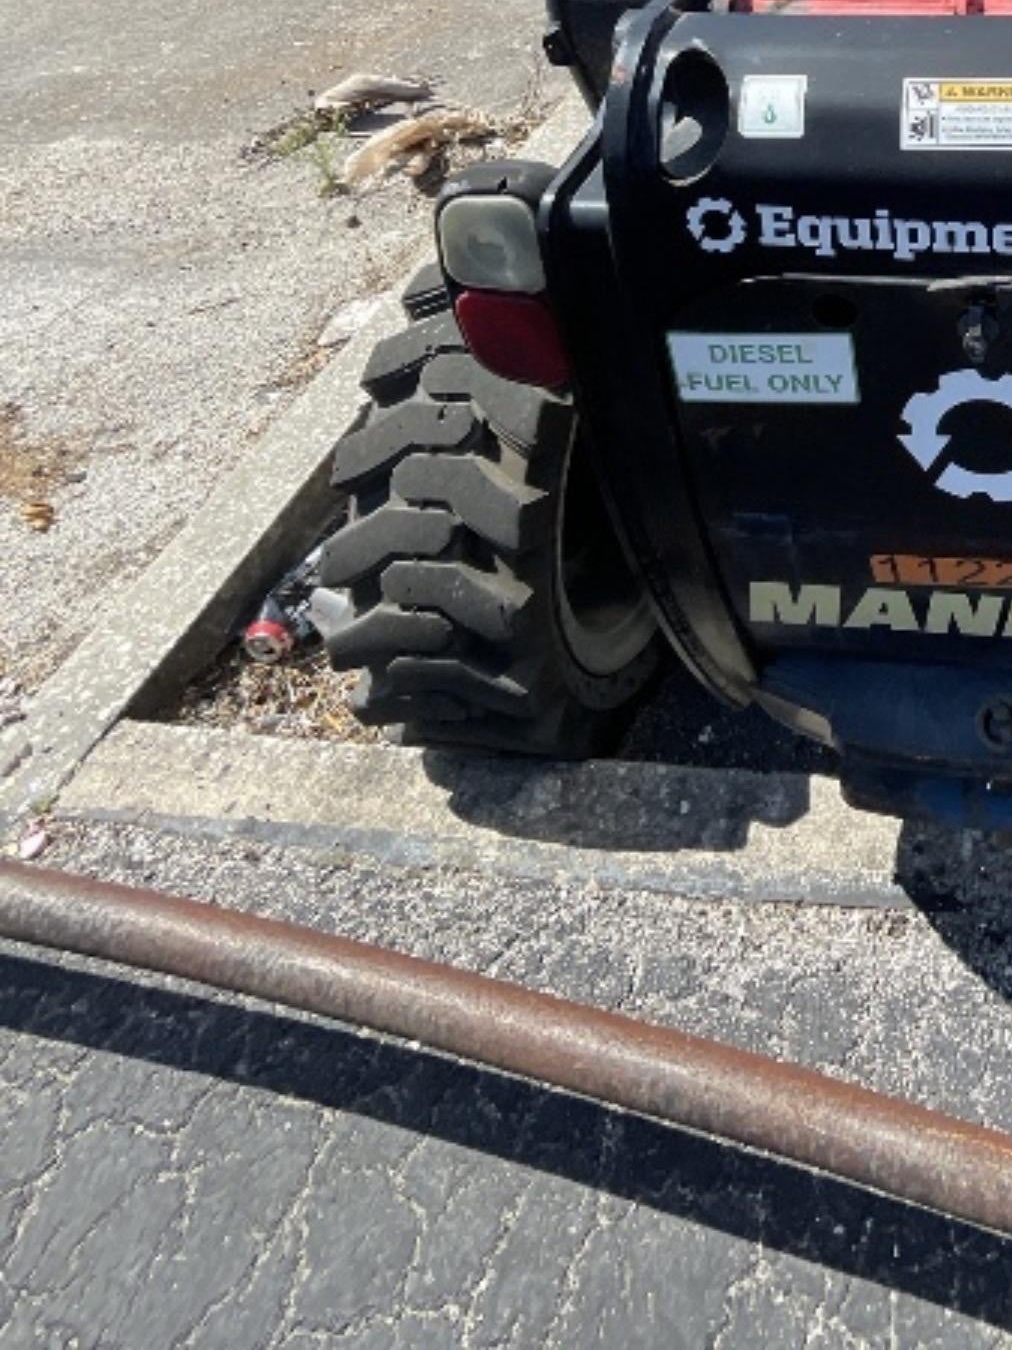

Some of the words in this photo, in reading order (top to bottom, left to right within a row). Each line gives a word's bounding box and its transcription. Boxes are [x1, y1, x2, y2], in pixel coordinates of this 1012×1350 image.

[707, 343, 814, 364] DIESEL
[686, 373, 759, 393] FUEL
[767, 374, 844, 395] ONLY
